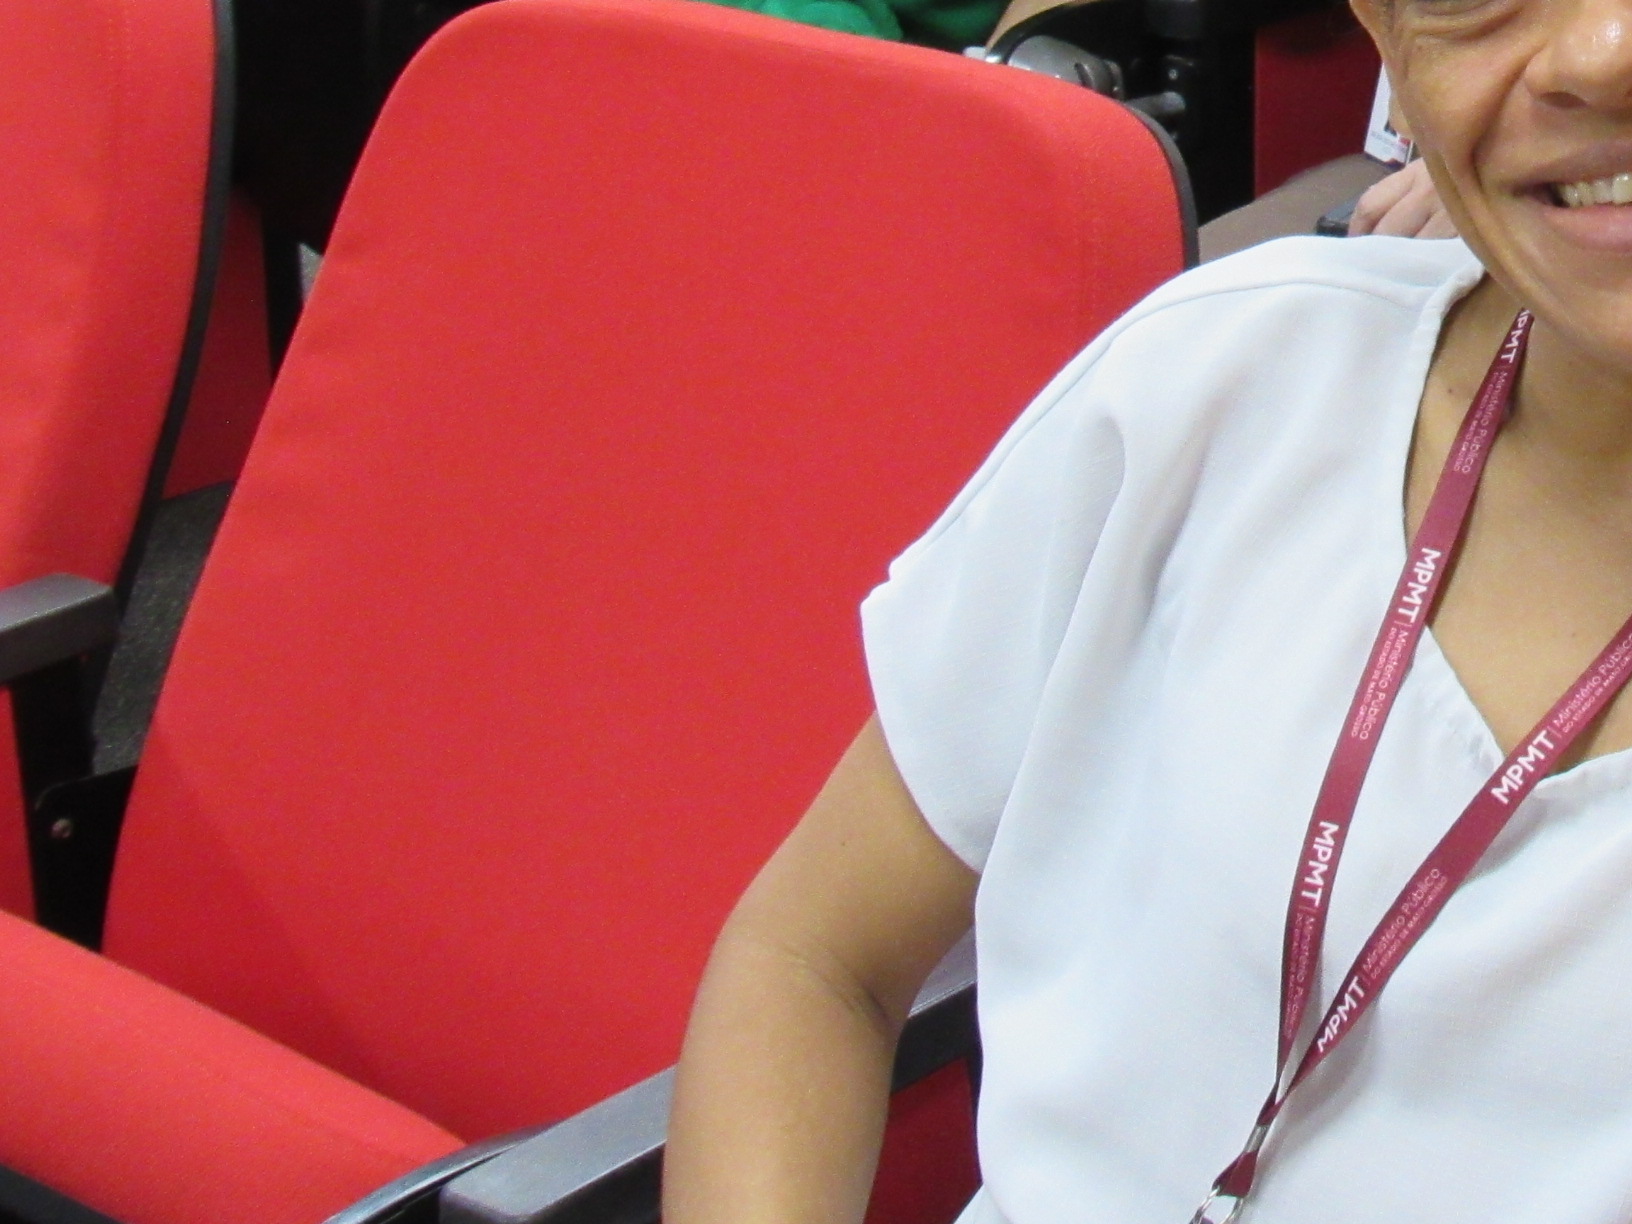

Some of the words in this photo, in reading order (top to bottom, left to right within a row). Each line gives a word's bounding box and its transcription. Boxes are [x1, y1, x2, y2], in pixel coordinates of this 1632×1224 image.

[1460, 426, 1487, 475] Público
[1397, 547, 1442, 624] MPMT
[1377, 628, 1409, 690] Ministério
[1358, 690, 1386, 741] Público
[1550, 671, 1602, 729] Ministério
[1491, 729, 1555, 805] MPMT
[1300, 821, 1340, 907] MPMT
[1359, 913, 1407, 973] Ministério
[1400, 865, 1442, 916] Público
[1316, 976, 1365, 1053] MPMT
